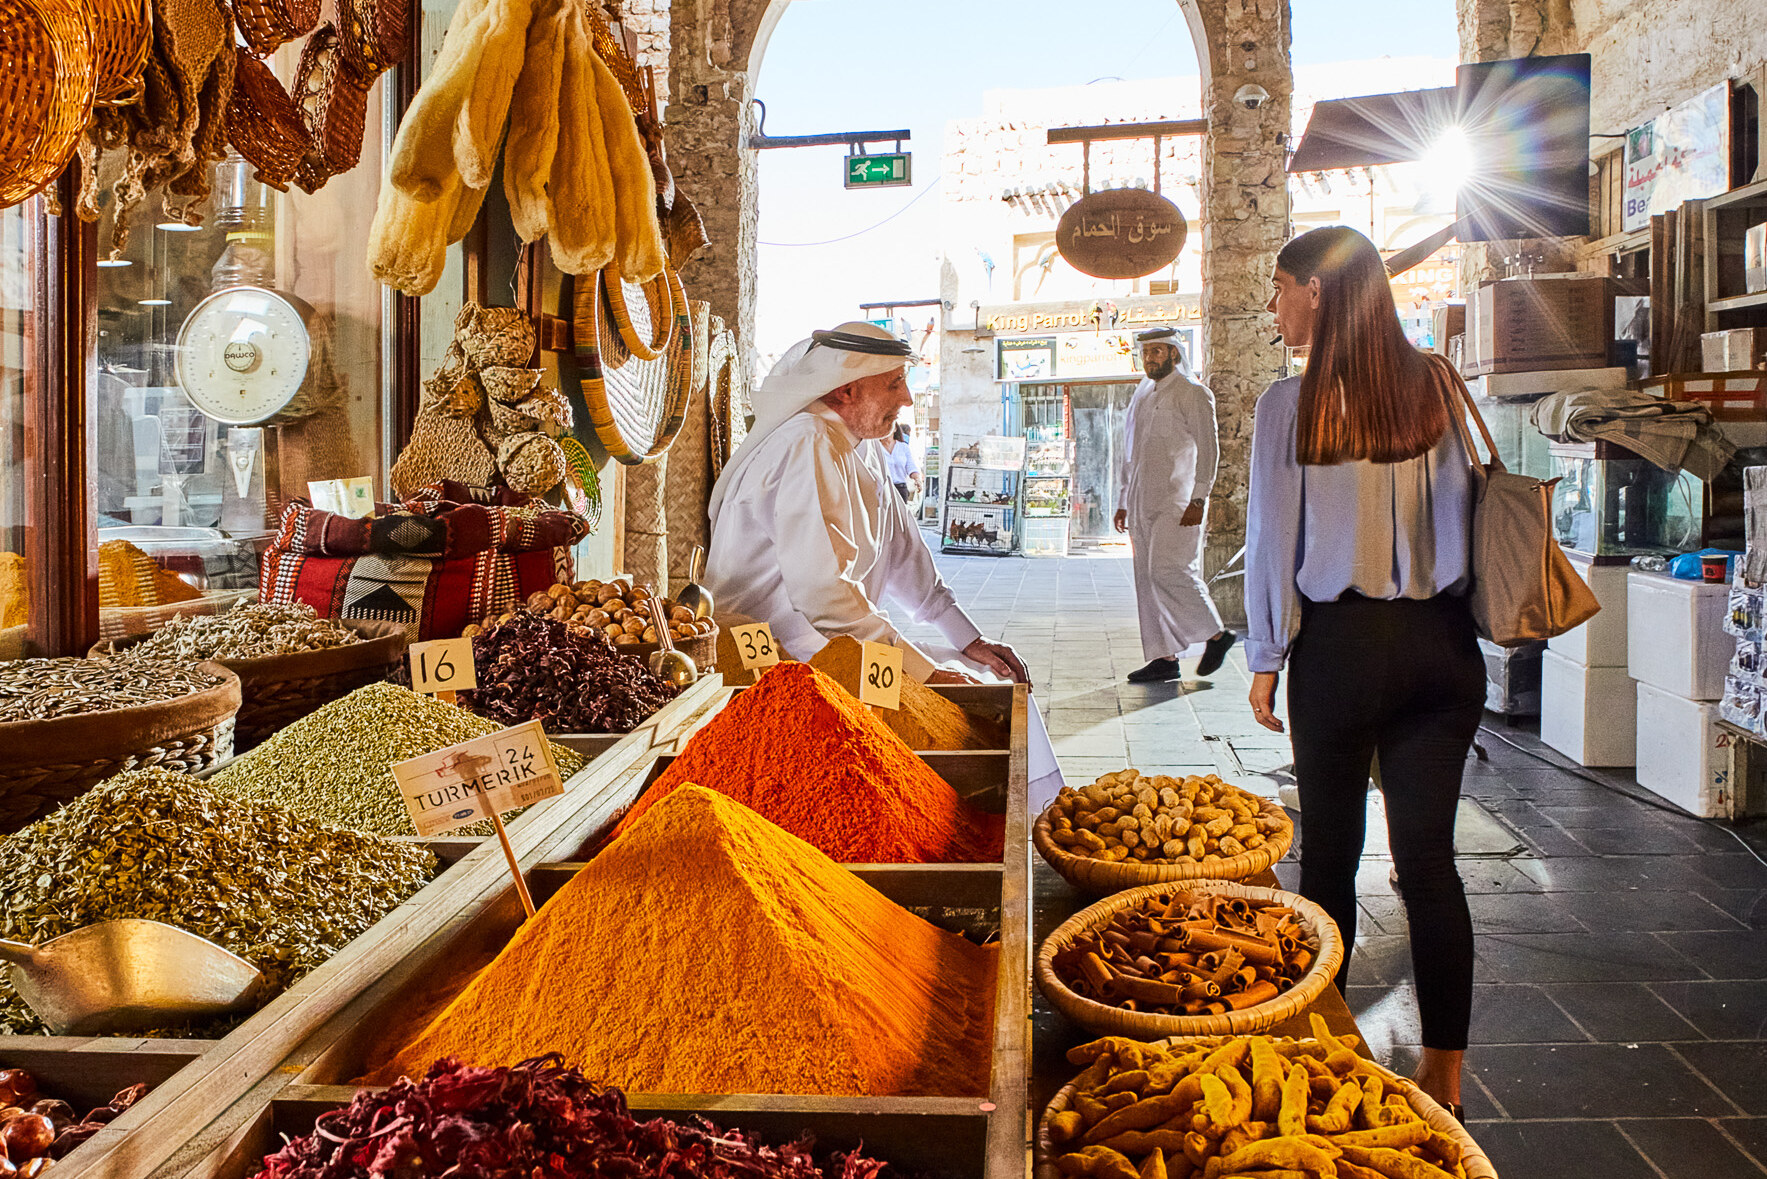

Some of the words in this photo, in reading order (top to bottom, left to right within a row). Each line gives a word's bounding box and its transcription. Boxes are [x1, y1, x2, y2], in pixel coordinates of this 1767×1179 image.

[1072, 213, 1120, 247] الحمام
[1128, 215, 1172, 243] سوق
[1391, 268, 1453, 285] KING
[987, 313, 1028, 332] King
[1032, 309, 1087, 330] Parrot
[1119, 303, 1186, 326] الببغاء
[224, 351, 255, 360] DAWCO
[741, 629, 773, 660] 32
[421, 649, 455, 684] 16
[868, 662, 894, 689] 20
[506, 745, 535, 765] 24
[414, 761, 537, 810] TURMERIK
